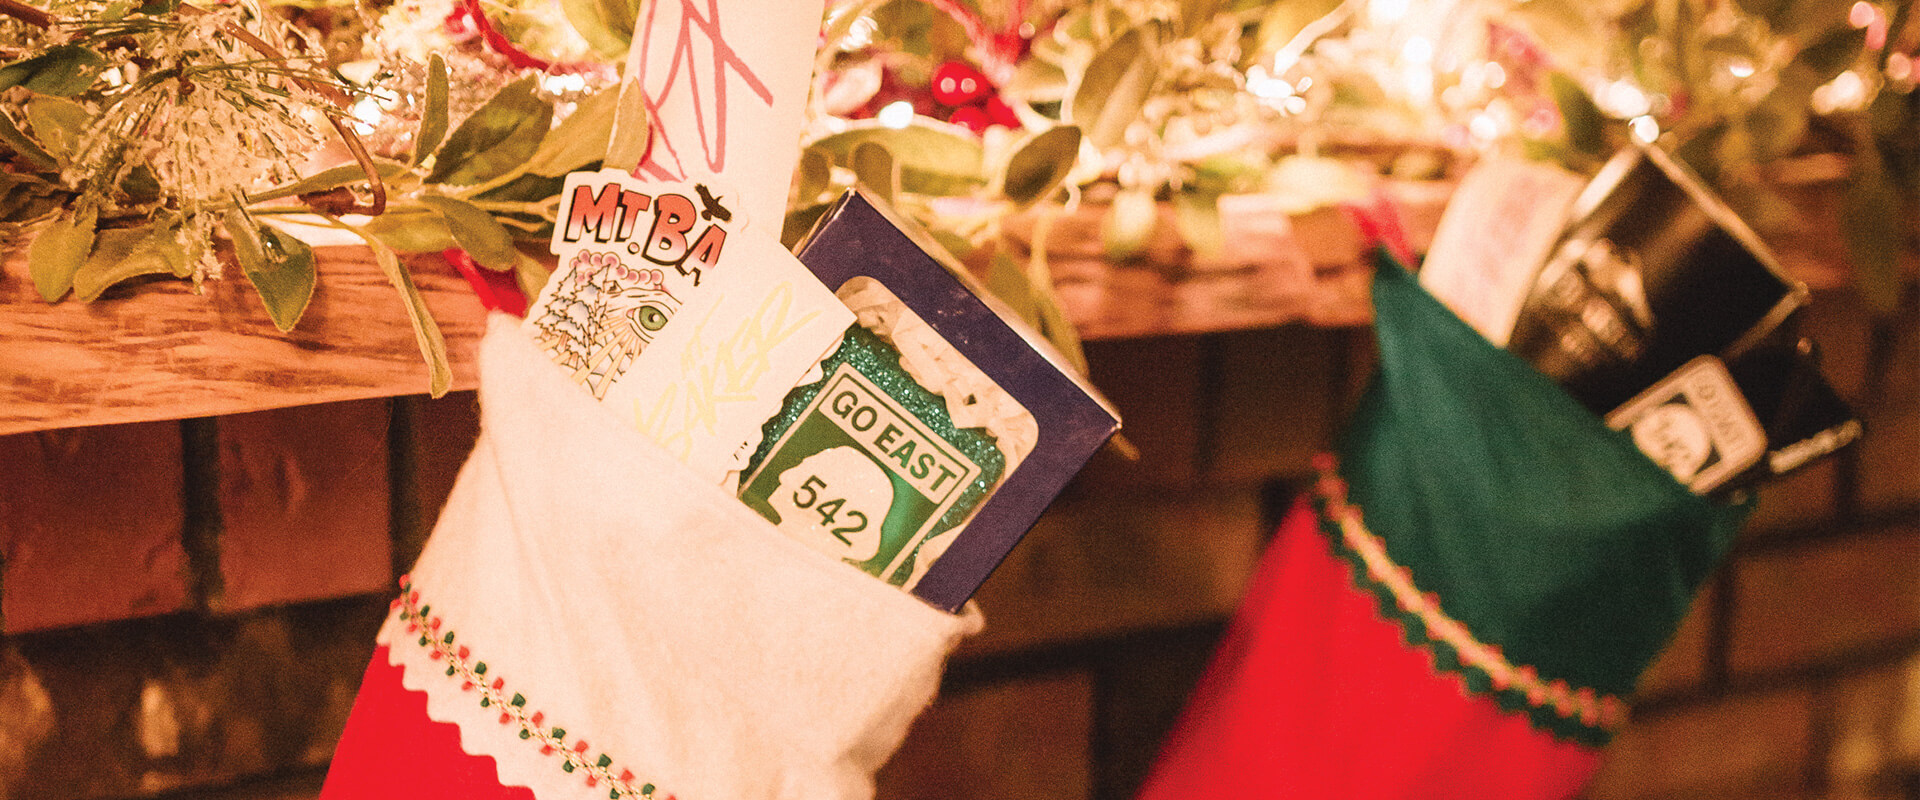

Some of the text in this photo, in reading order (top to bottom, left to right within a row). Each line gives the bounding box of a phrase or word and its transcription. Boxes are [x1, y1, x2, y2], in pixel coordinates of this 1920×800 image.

[832, 390, 958, 493] GO EAST
[793, 474, 868, 547] 542
